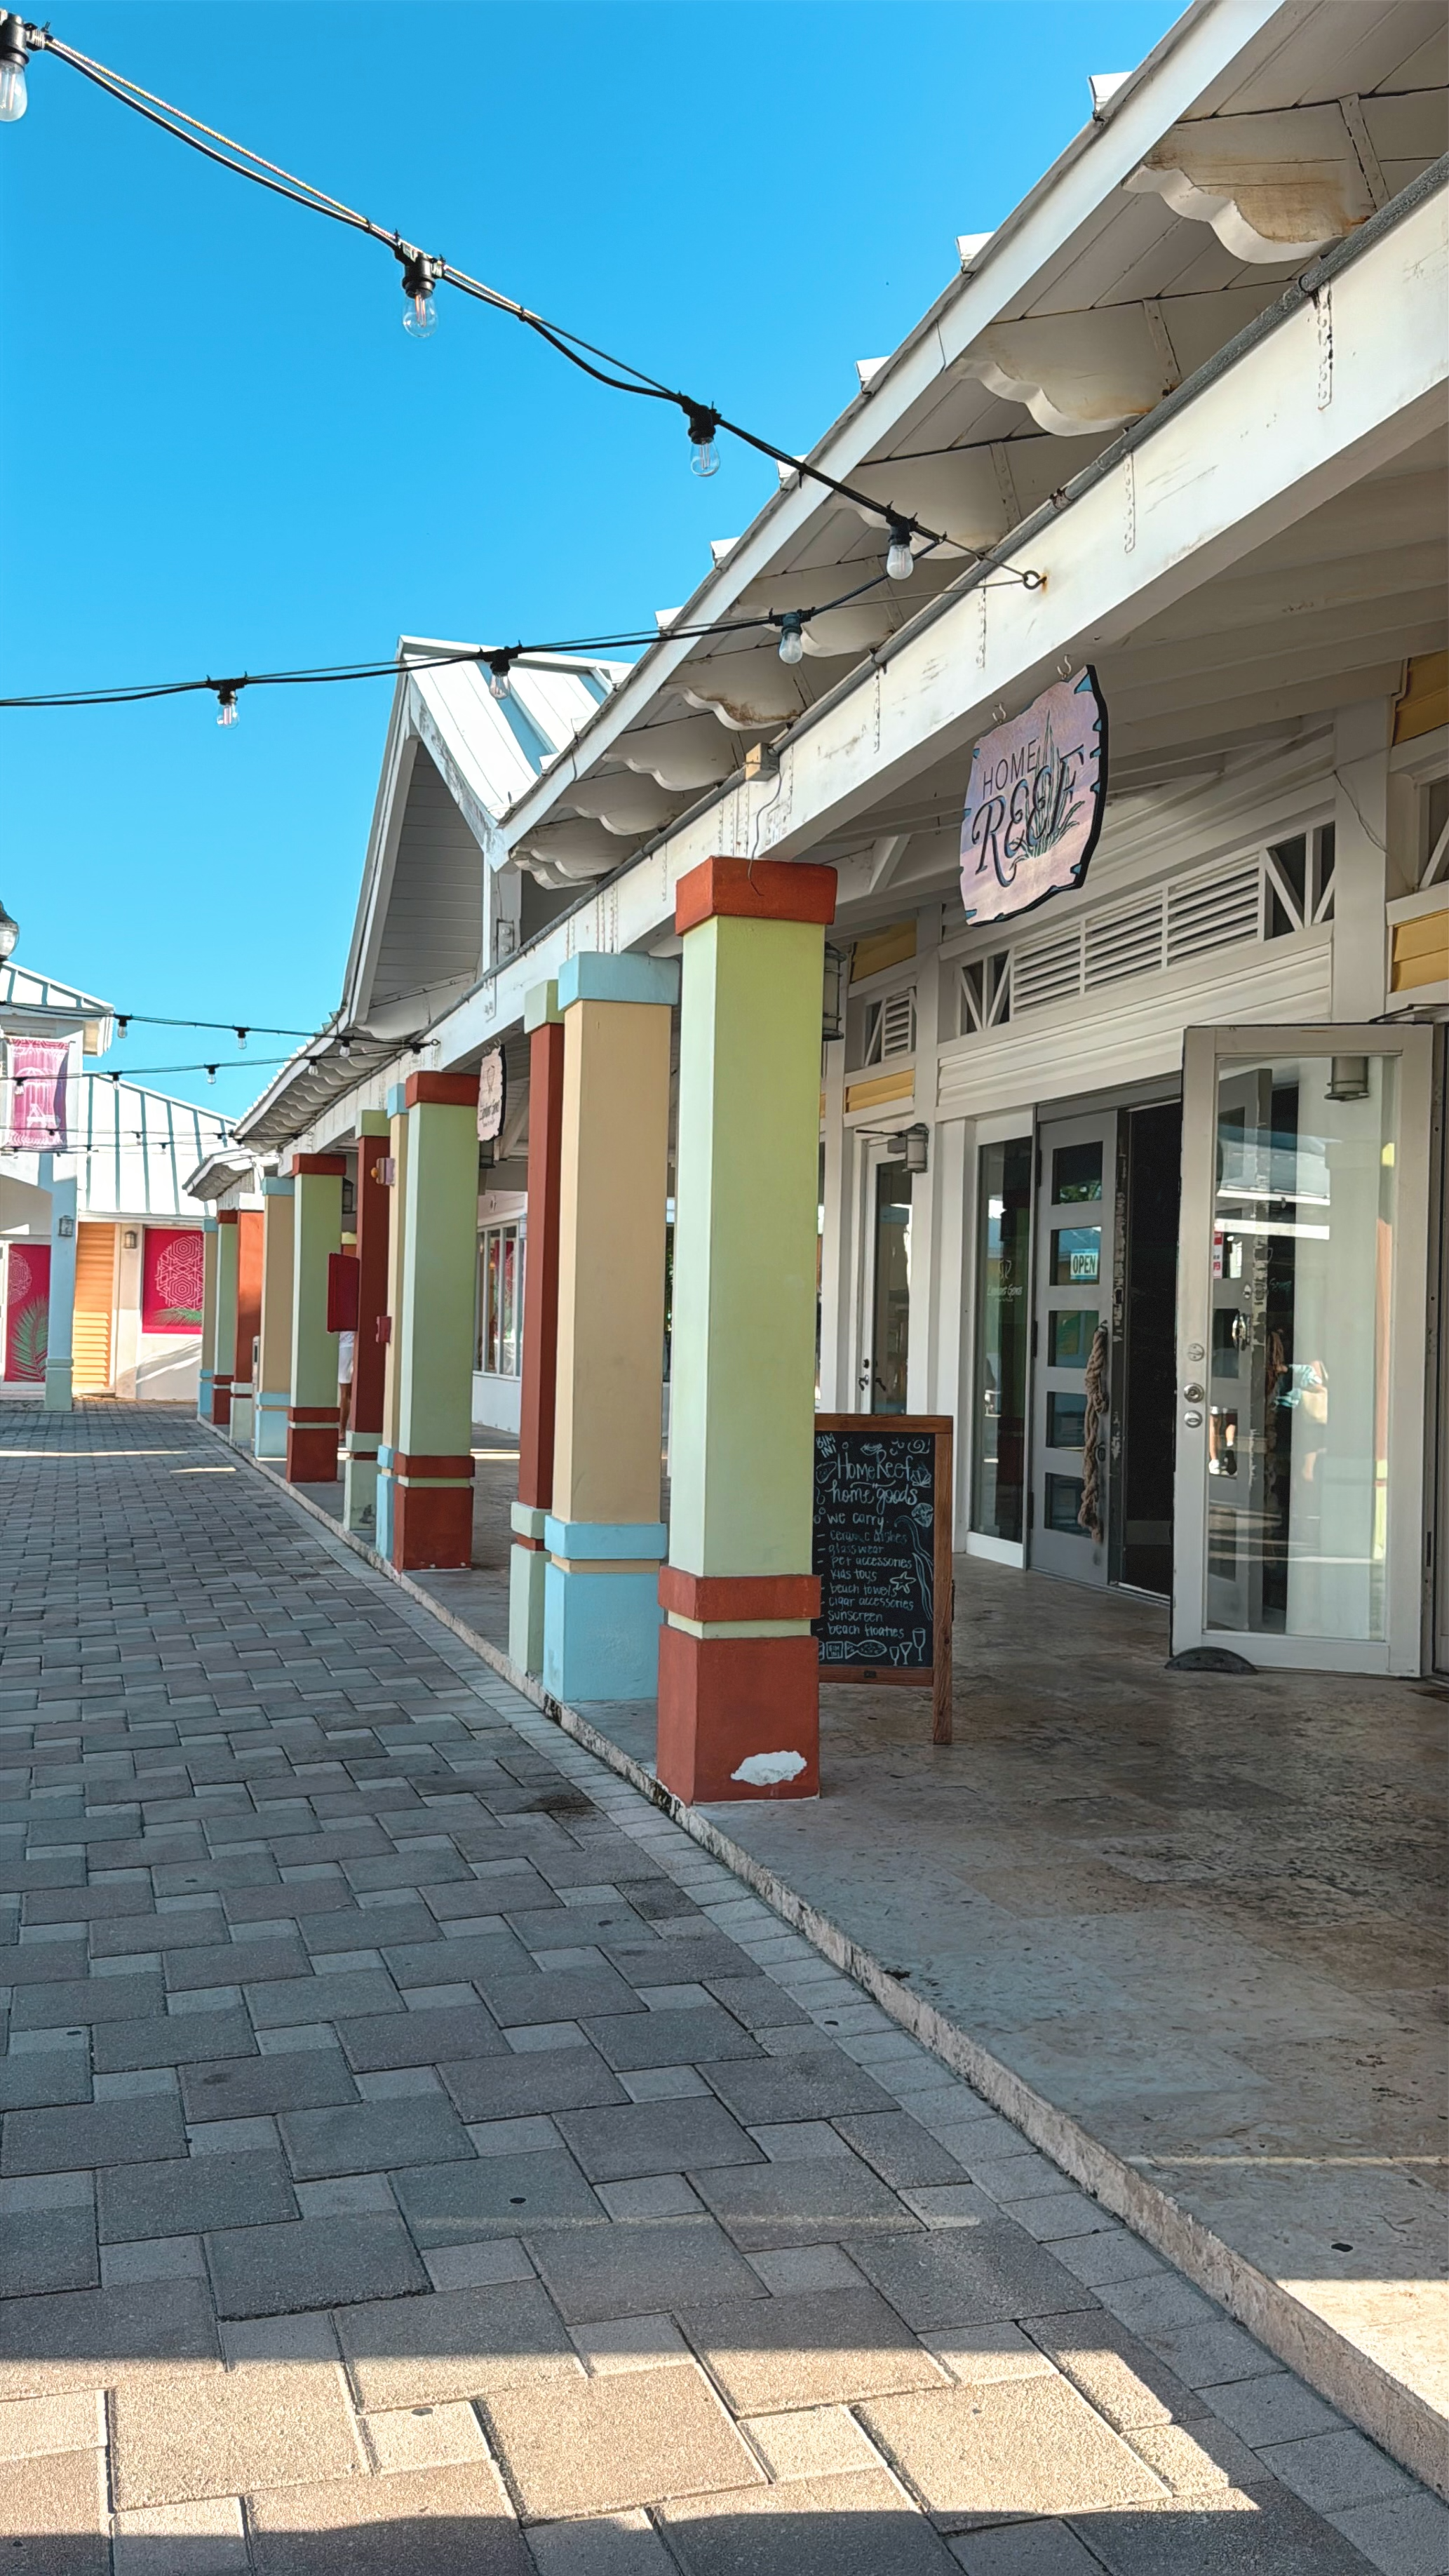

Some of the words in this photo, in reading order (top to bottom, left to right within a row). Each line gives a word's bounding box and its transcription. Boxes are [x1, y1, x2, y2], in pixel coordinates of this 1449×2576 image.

[983, 739, 1037, 800] HOME
[973, 744, 1084, 887] REEF
[1072, 1254, 1096, 1274] OPEN
[816, 1433, 836, 1449] BIM
[821, 1444, 837, 1458] INI
[876, 1449, 913, 1482] Reef
[825, 1480, 875, 1504] home
[877, 1484, 917, 1515] goods
[827, 1512, 846, 1524] we
[830, 1529, 870, 1543] cerac
[873, 1529, 908, 1543] dishes
[831, 1556, 851, 1569] pet
[856, 1557, 912, 1569] accessories
[854, 1569, 877, 1584] toys
[830, 1583, 860, 1595] beach
[863, 1583, 897, 1597] towels
[828, 1597, 855, 1610] cigar
[858, 1597, 914, 1611] accessories
[828, 1623, 860, 1635] beach
[864, 1624, 904, 1639] floaties
